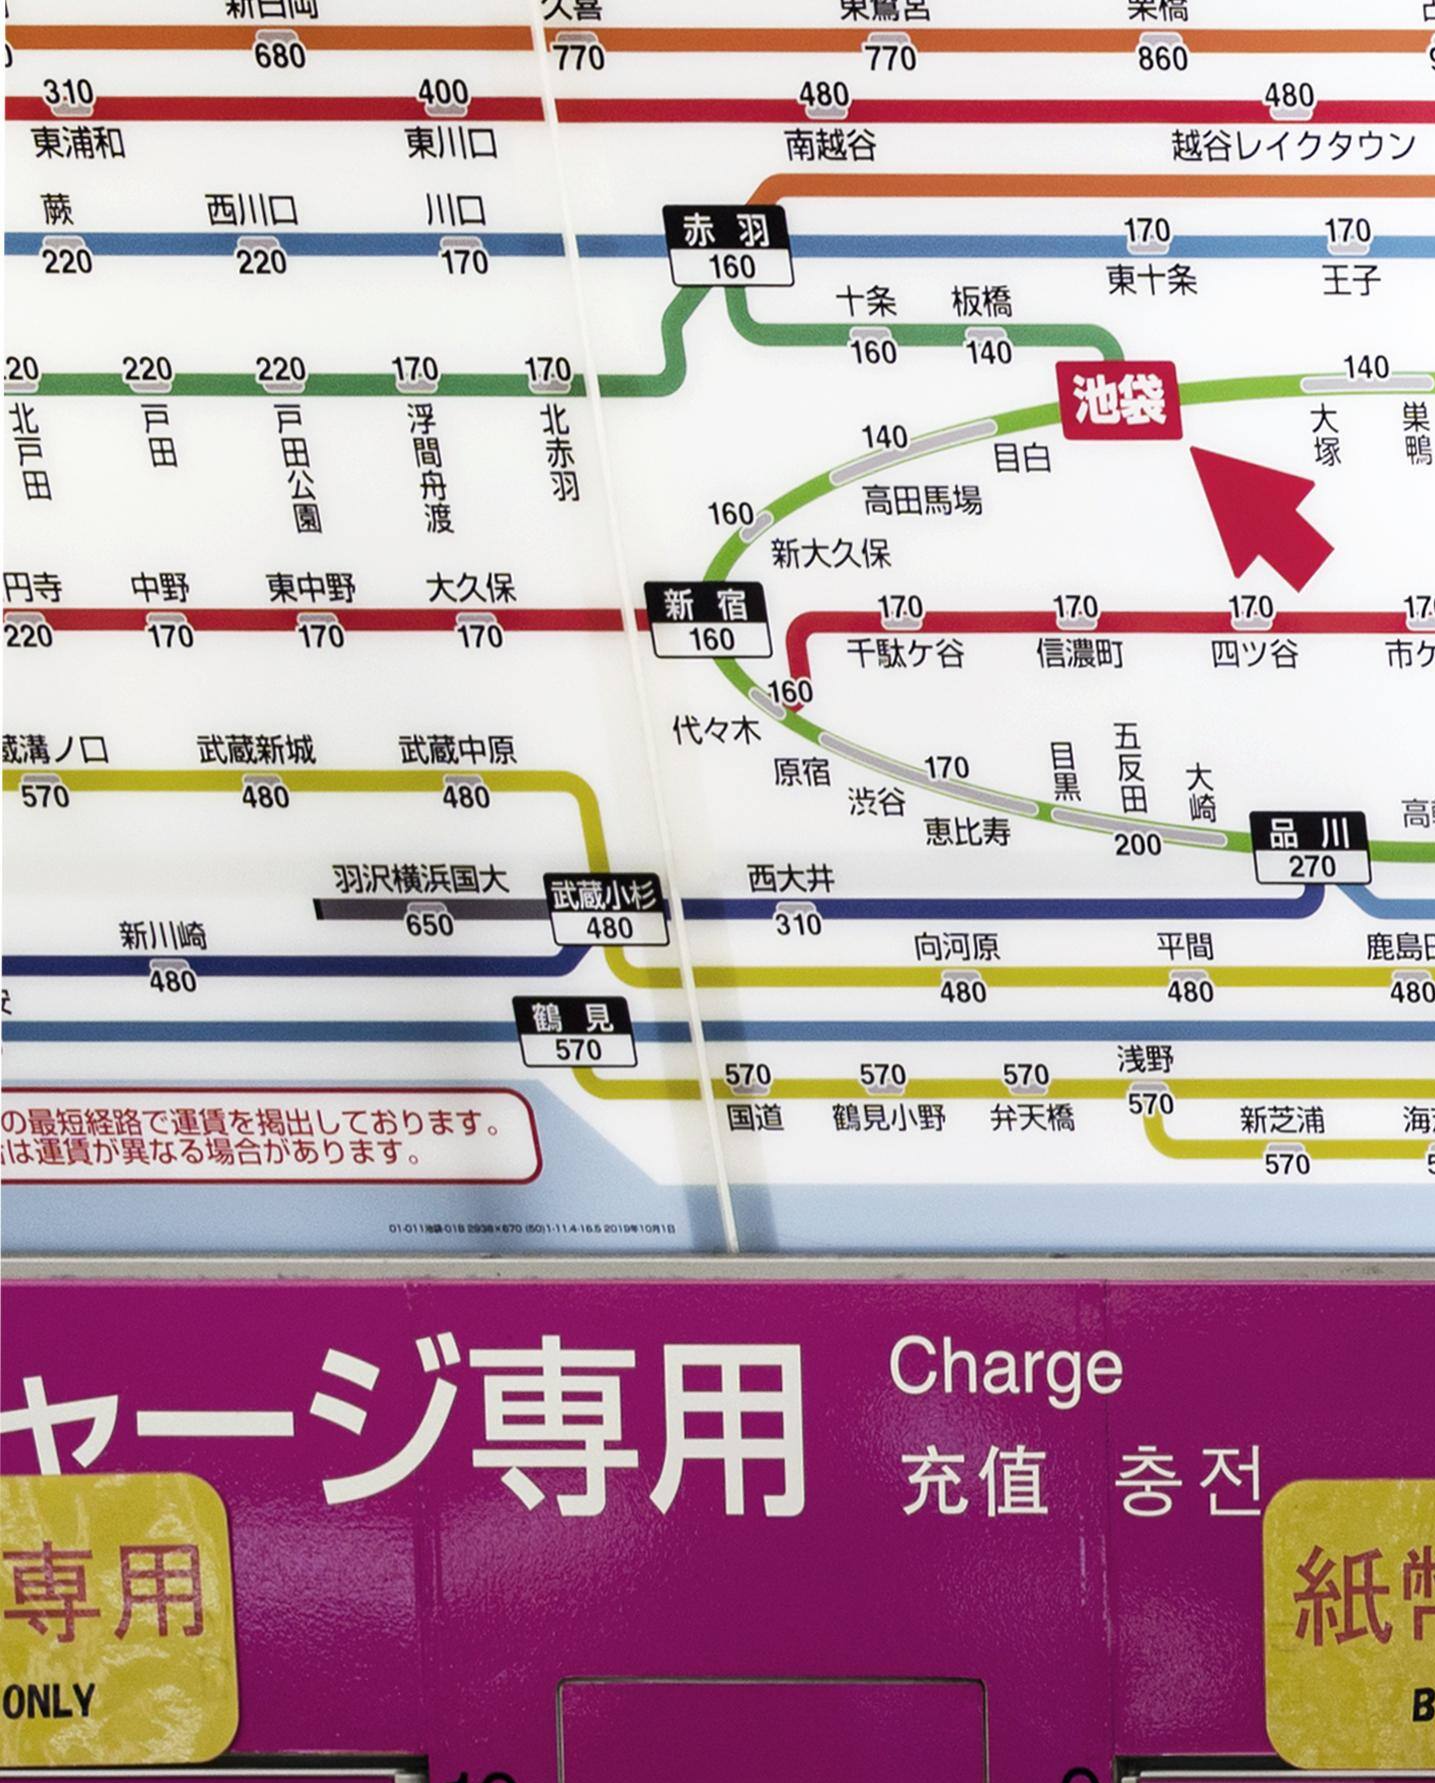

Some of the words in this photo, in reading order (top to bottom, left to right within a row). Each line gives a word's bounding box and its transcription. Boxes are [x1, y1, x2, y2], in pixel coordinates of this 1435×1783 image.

[43, 78, 94, 105] 310
[31, 125, 126, 160] 東浦和
[1171, 128, 1416, 163] 越谷レイクタウン
[709, 254, 756, 279] 160
[1106, 263, 1198, 296] 東十条
[1073, 373, 1167, 425] 池袋
[273, 404, 323, 534] 戸田公園
[407, 402, 455, 534] 浮間舟渡
[861, 484, 983, 516] 高田馬場
[196, 733, 317, 765] 武蔵新城
[332, 863, 510, 894] 羽沢横浜国大
[0, 1137, 419, 1167] は運賃が異なる場合があります。
[890, 1334, 1123, 1410] Charge
[901, 1444, 1049, 1518] 充值
[1114, 1444, 1261, 1517] 충전
[3, 1683, 95, 1719] ONLY
